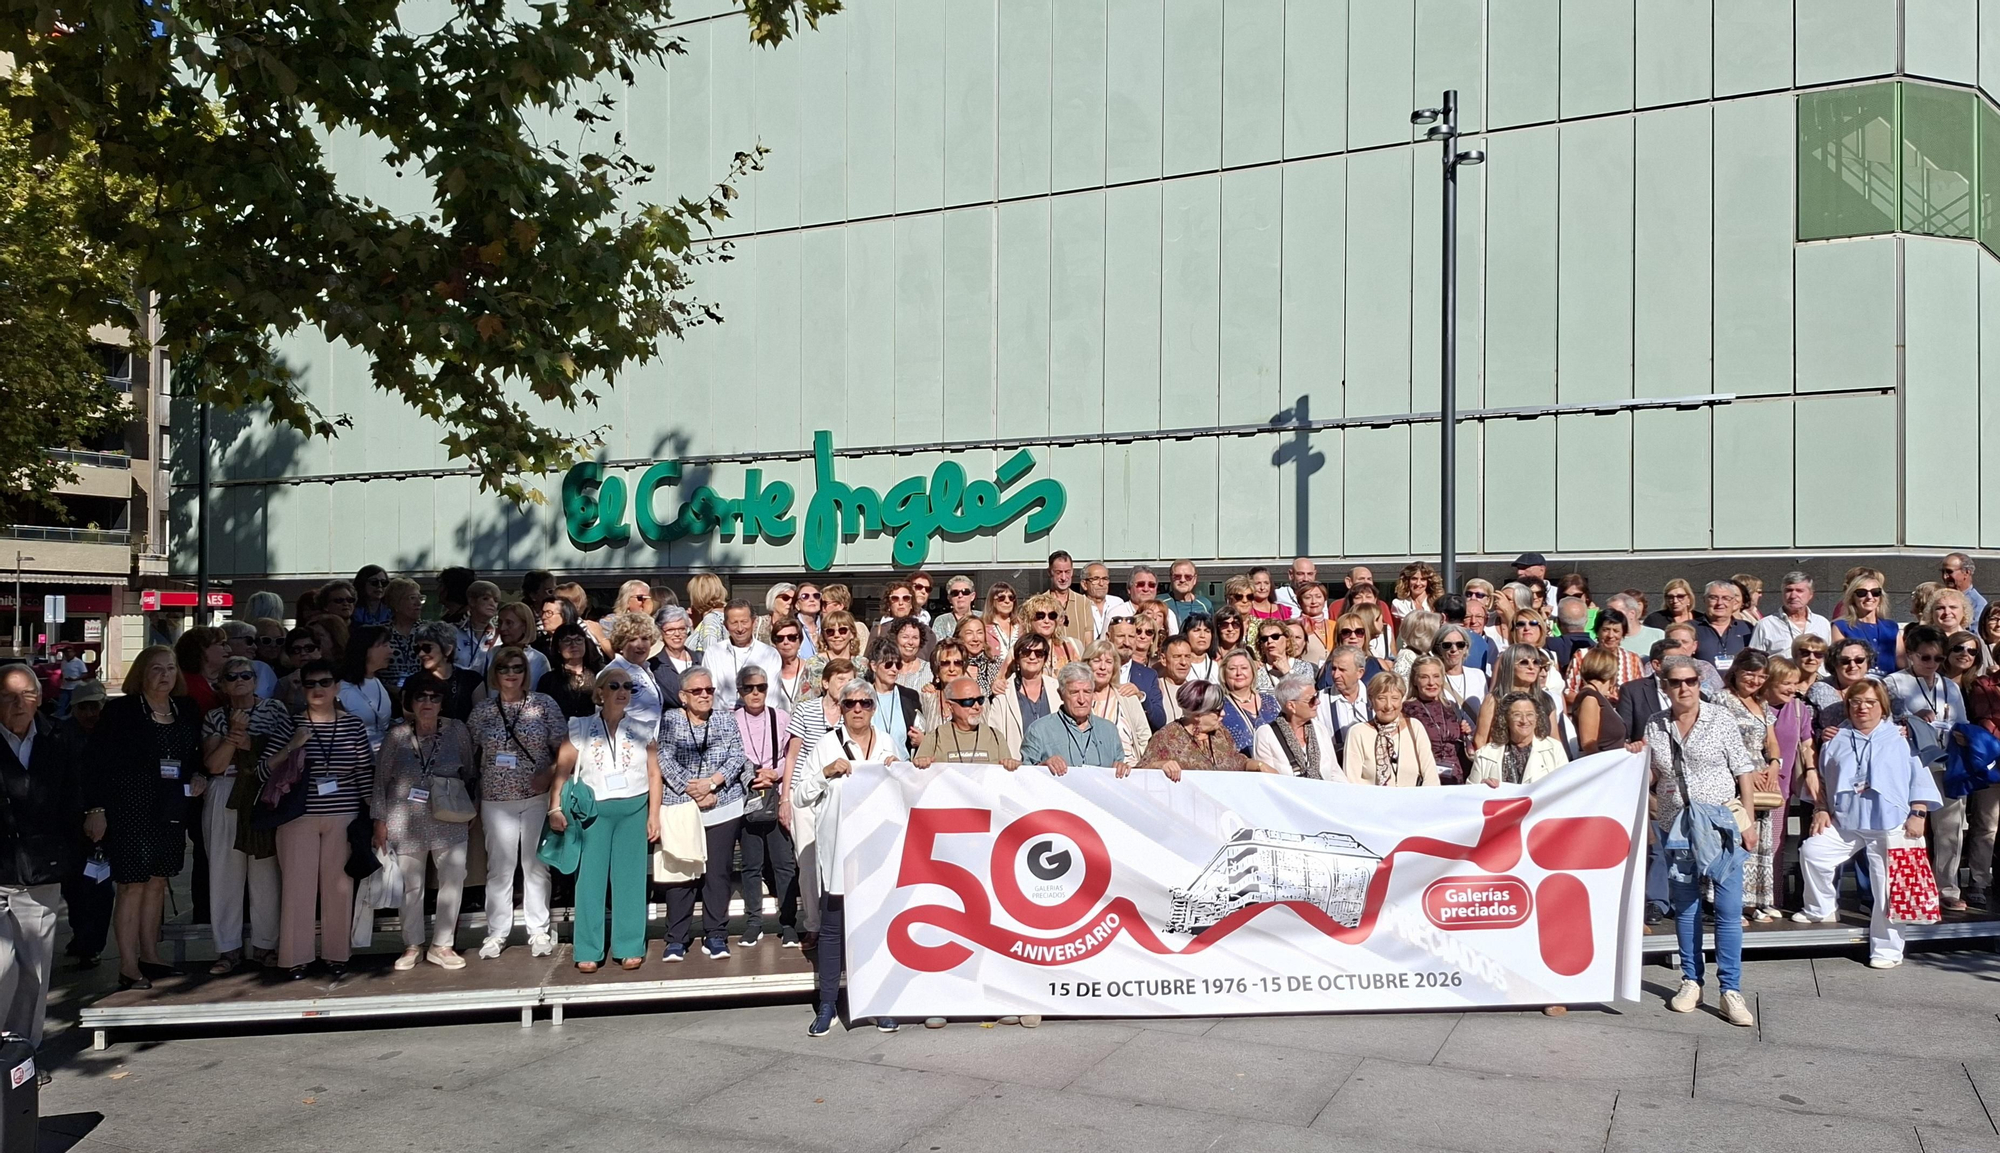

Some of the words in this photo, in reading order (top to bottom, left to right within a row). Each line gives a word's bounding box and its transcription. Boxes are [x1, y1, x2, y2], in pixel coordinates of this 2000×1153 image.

[562, 460, 630, 542] El
[635, 460, 797, 543] Corte
[803, 430, 1067, 571] Inglés
[1027, 840, 1072, 881] G
[887, 807, 1112, 972] 50
[1444, 888, 1510, 903] Galerías
[1440, 902, 1517, 921] preciados
[1009, 913, 1120, 962] ANIVERSARIO
[1048, 982, 1070, 996] 15
[1076, 982, 1102, 998] DE
[1106, 978, 1197, 997] OCTUBRE
[1201, 977, 1248, 994] 1976
[1287, 976, 1313, 992] DE
[1317, 973, 1410, 991] OCTUBRE
[1414, 971, 1463, 988] 2026
